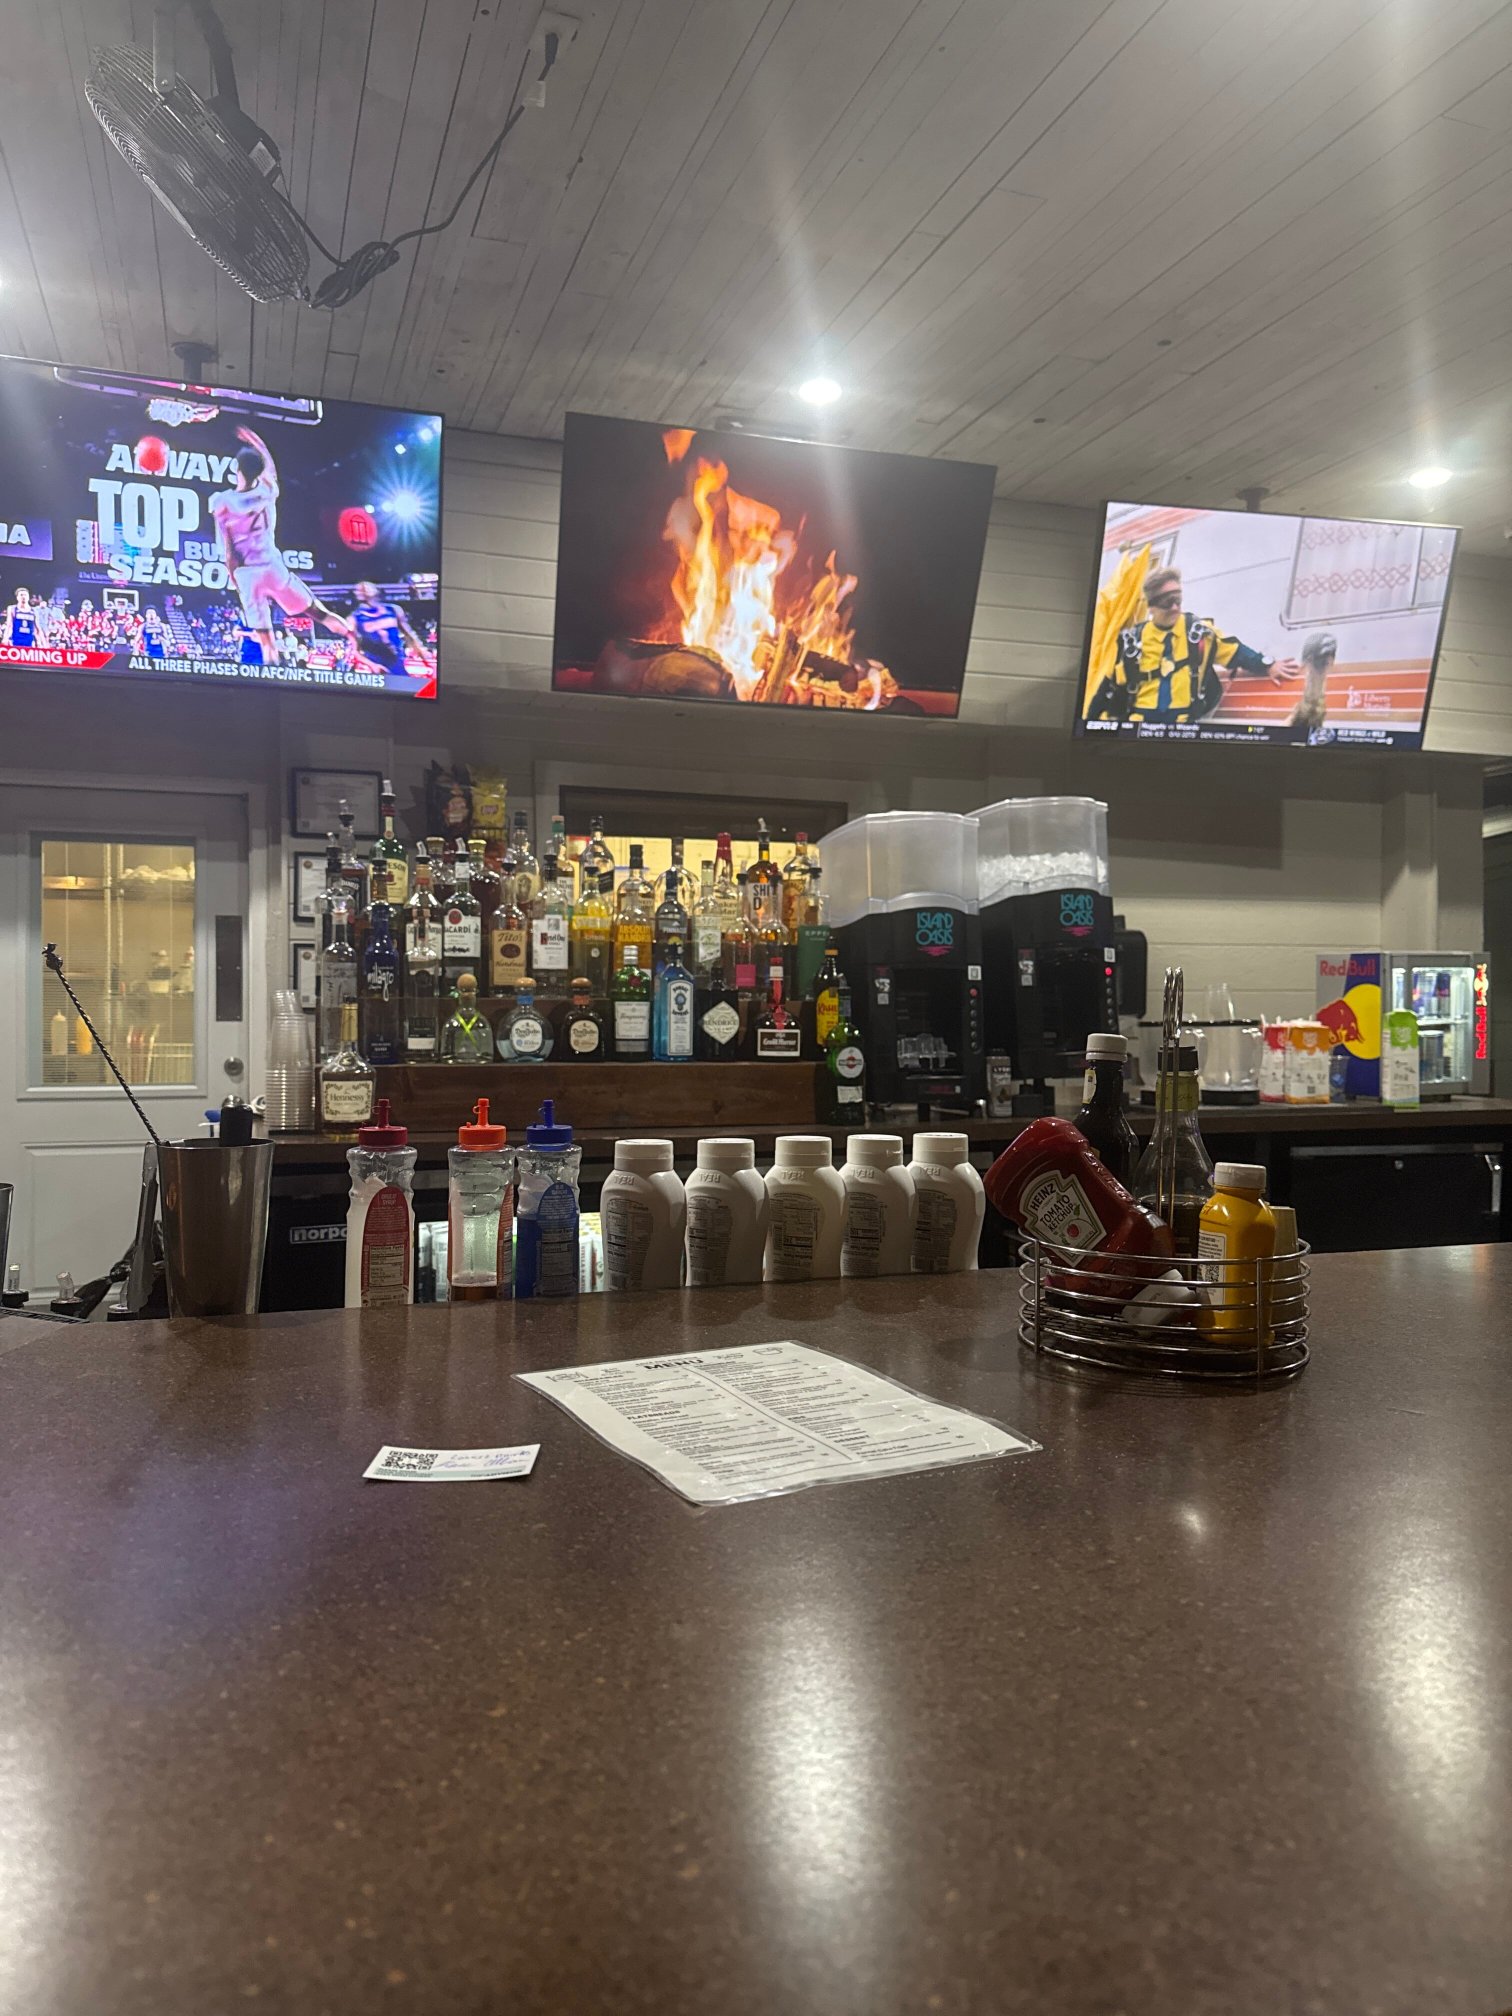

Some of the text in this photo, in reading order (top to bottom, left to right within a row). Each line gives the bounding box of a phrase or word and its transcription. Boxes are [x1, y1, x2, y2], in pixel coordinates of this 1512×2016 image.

[88, 477, 200, 552] TOP
[107, 553, 238, 591] SEASO
[0, 645, 88, 665] COMING UP
[128, 656, 385, 688] ALL THREE PHASES ON AFC/NFC TITLE GAMES
[1060, 893, 1094, 911] ISLAND
[916, 911, 954, 929] ISLAND
[1059, 910, 1095, 926] OASIS
[497, 931, 523, 943] Tito's
[915, 929, 954, 945] OASIS
[1319, 957, 1376, 976] Red Bull
[329, 1093, 364, 1103] Hennessy
[1029, 1183, 1057, 1212] HEINZ
[1040, 1194, 1070, 1227] TOMATO
[1047, 1202, 1075, 1232] KETCHUP
[293, 1226, 348, 1241] norpo
[644, 1359, 704, 1370] MENU
